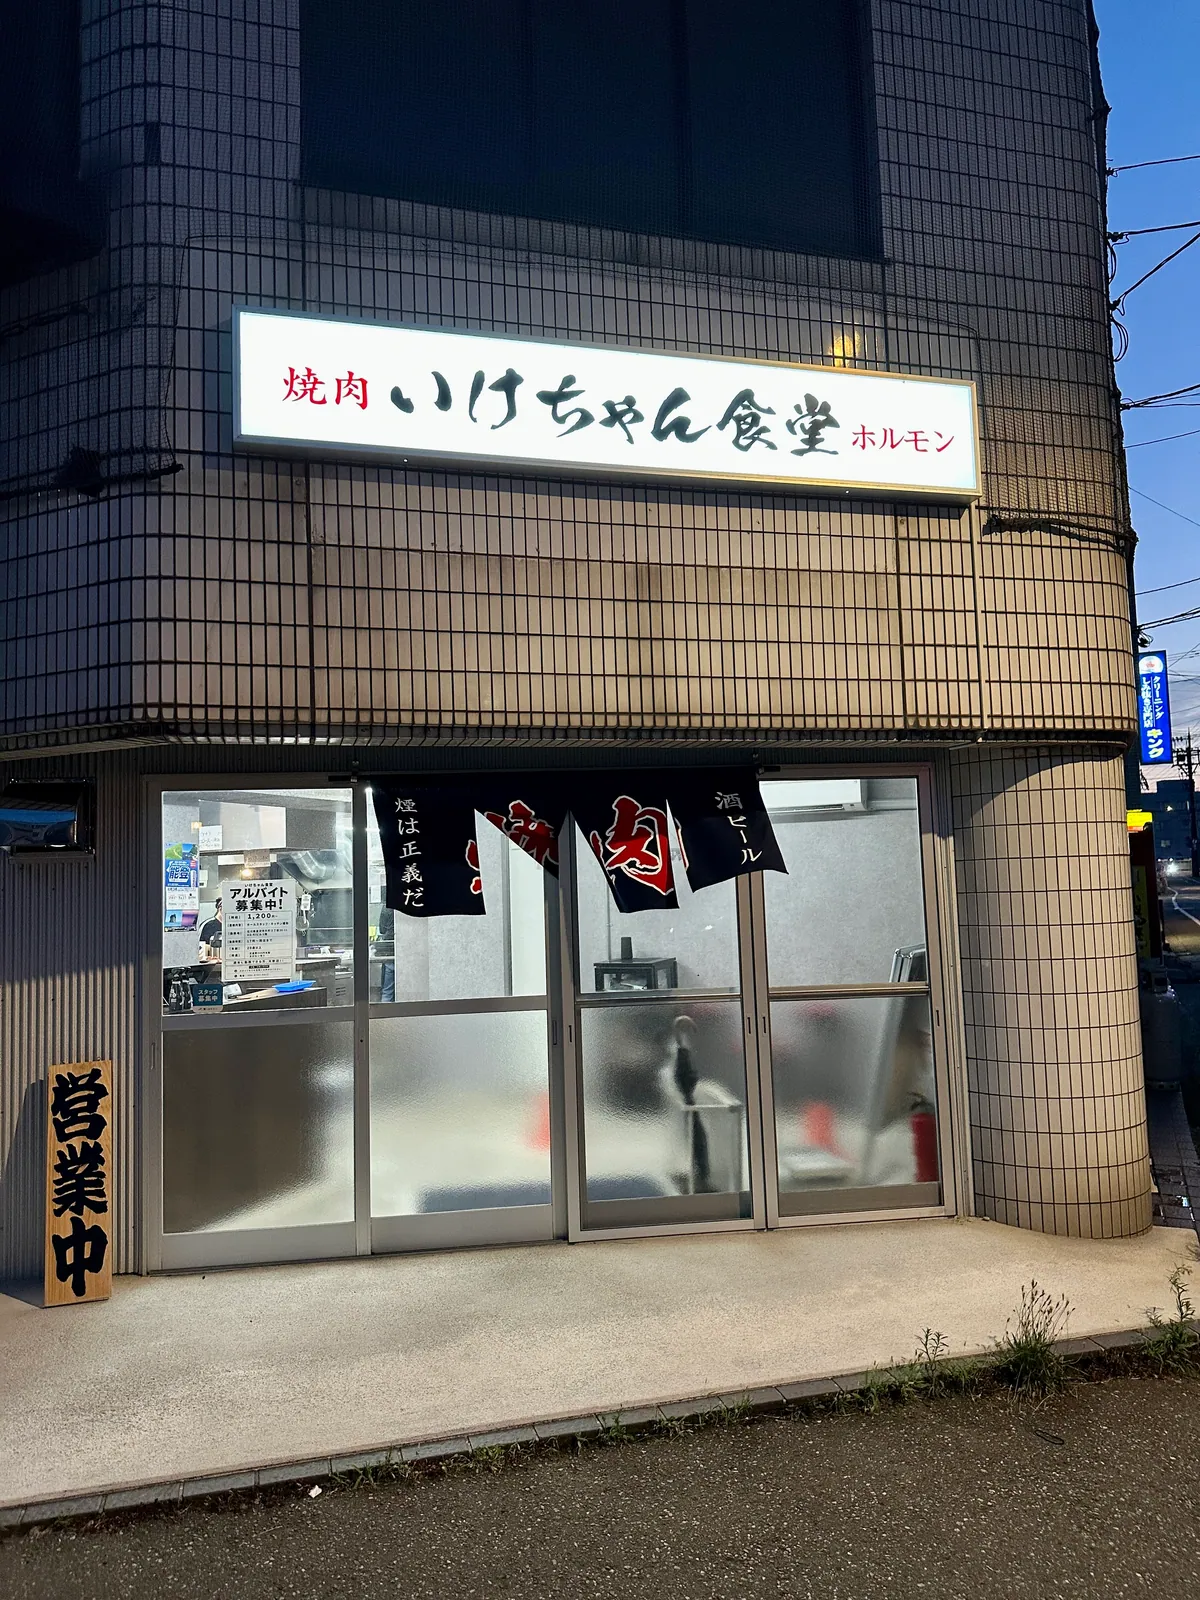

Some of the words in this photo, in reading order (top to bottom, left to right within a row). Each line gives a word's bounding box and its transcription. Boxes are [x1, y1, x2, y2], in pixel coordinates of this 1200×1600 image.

[282, 366, 369, 410] 焼肉
[390, 368, 841, 457] いけちゃん食堂
[851, 423, 956, 454] ホルモン
[229, 887, 289, 899] アルバイト
[394, 797, 425, 908] 煙は正義だ
[235, 899, 283, 912] 募集中!
[51, 1067, 109, 1297] 営業中
